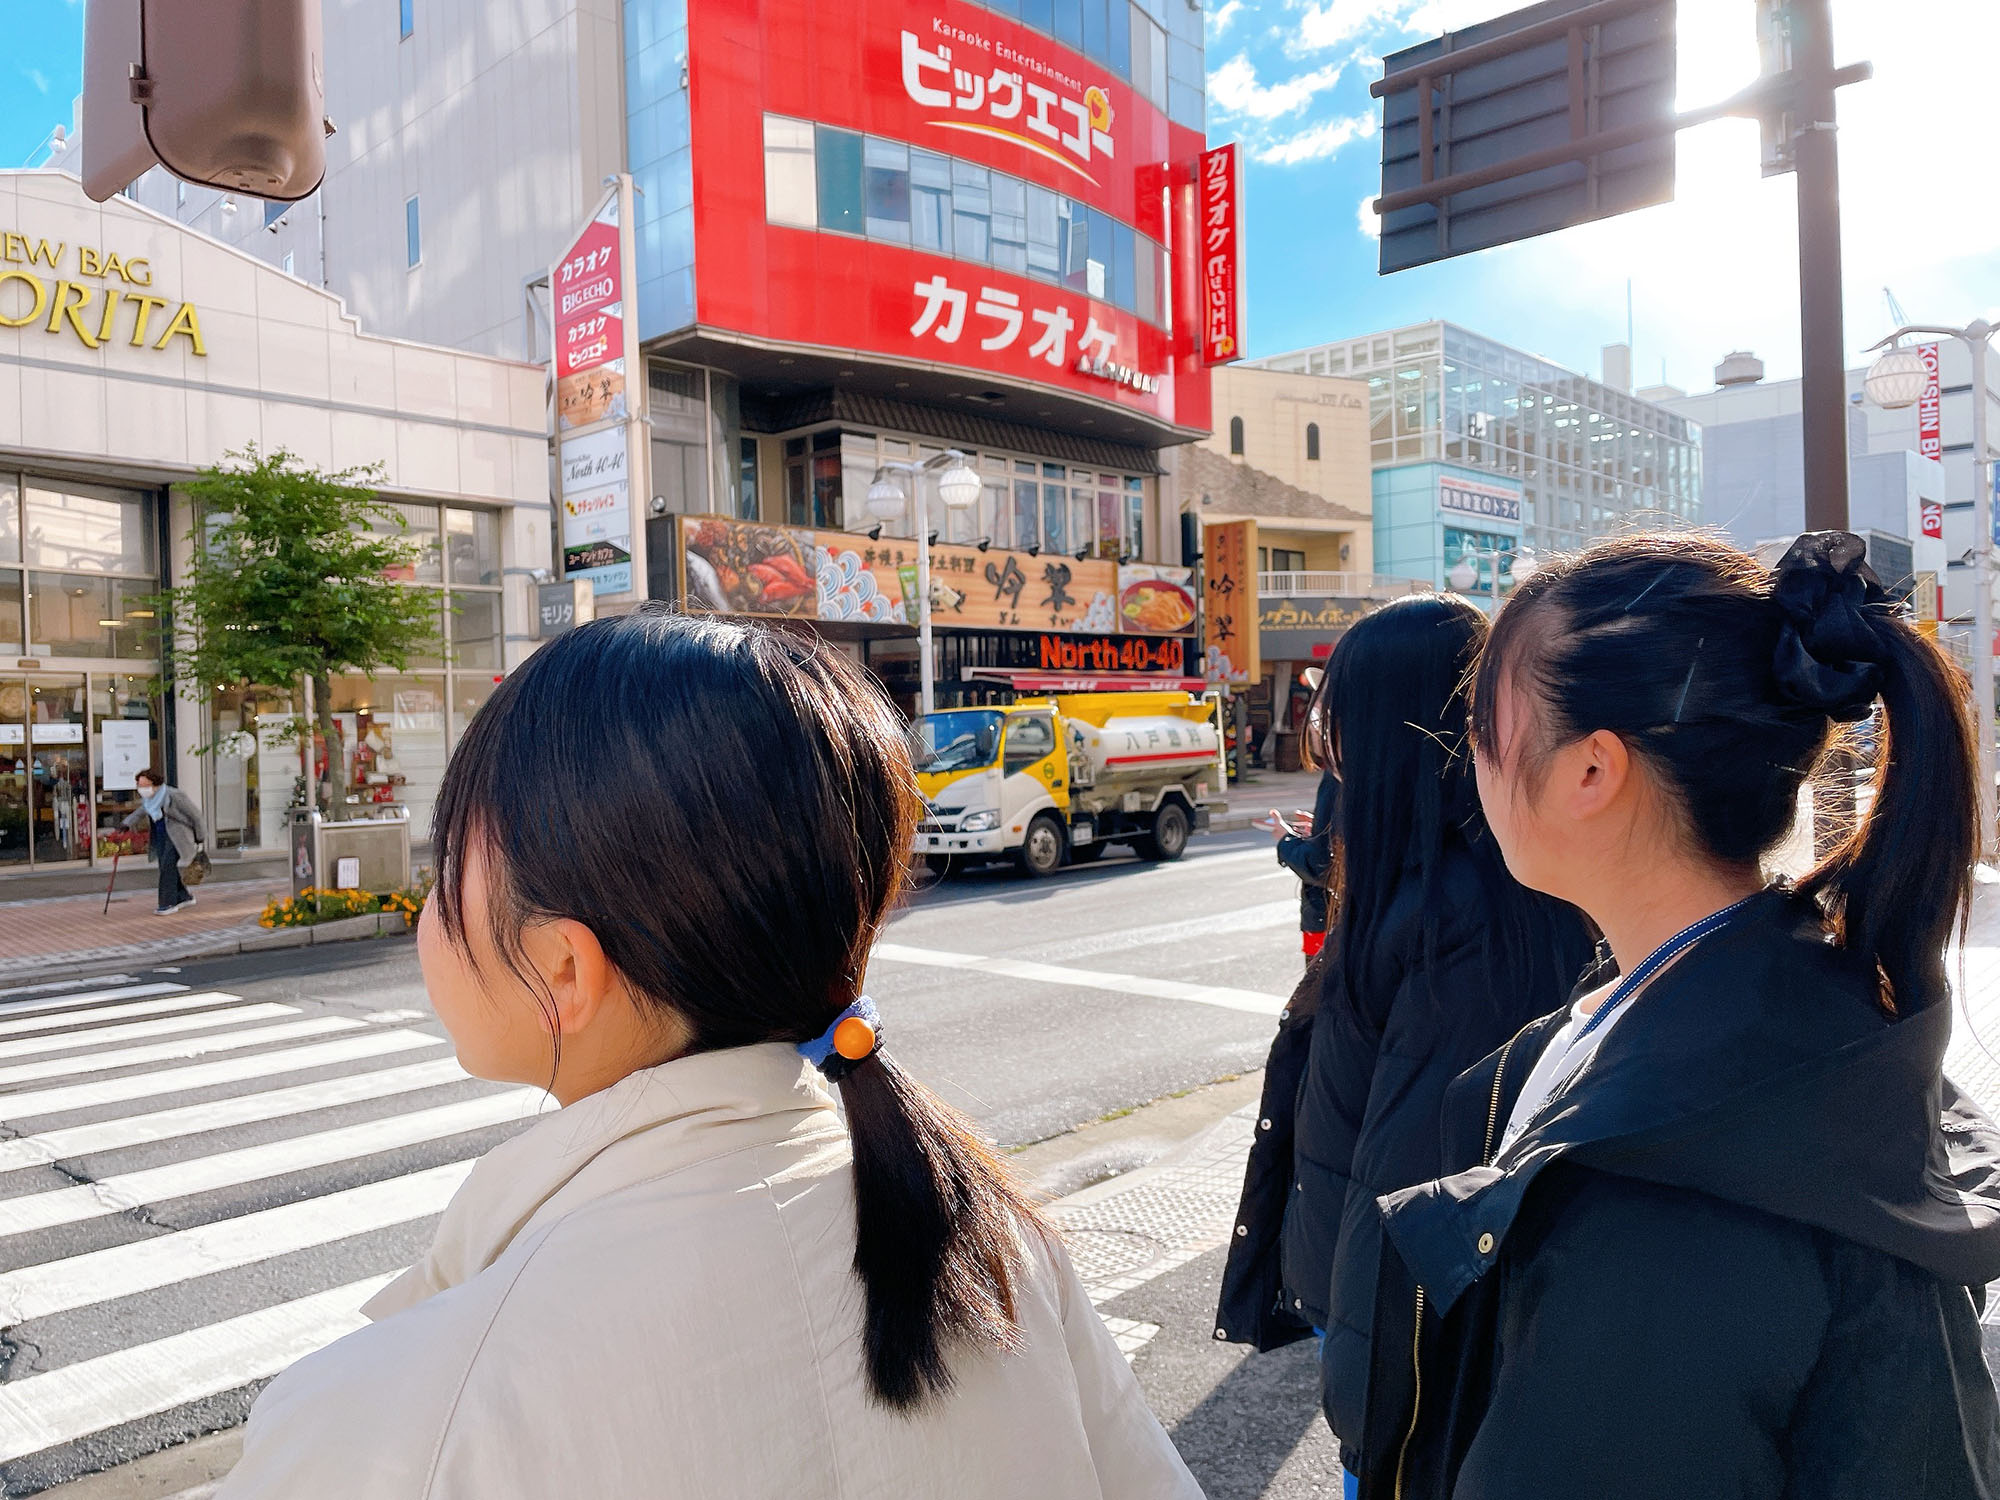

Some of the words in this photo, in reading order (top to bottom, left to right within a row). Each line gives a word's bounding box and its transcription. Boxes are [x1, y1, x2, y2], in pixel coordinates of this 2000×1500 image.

[932, 17, 991, 51] Karaoke
[995, 42, 1082, 92] Entertainment
[901, 30, 1115, 162] ビッグエコー
[1207, 152, 1231, 252] カラオケ
[0, 231, 66, 269] EW
[79, 246, 153, 286] BAG
[562, 246, 612, 284] カラオケ
[568, 316, 608, 344] カラオケ
[910, 275, 1118, 367] カラオケ
[541, 604, 574, 625] モリタ
[1040, 634, 1119, 670] North
[1120, 639, 1184, 671] 40-40
